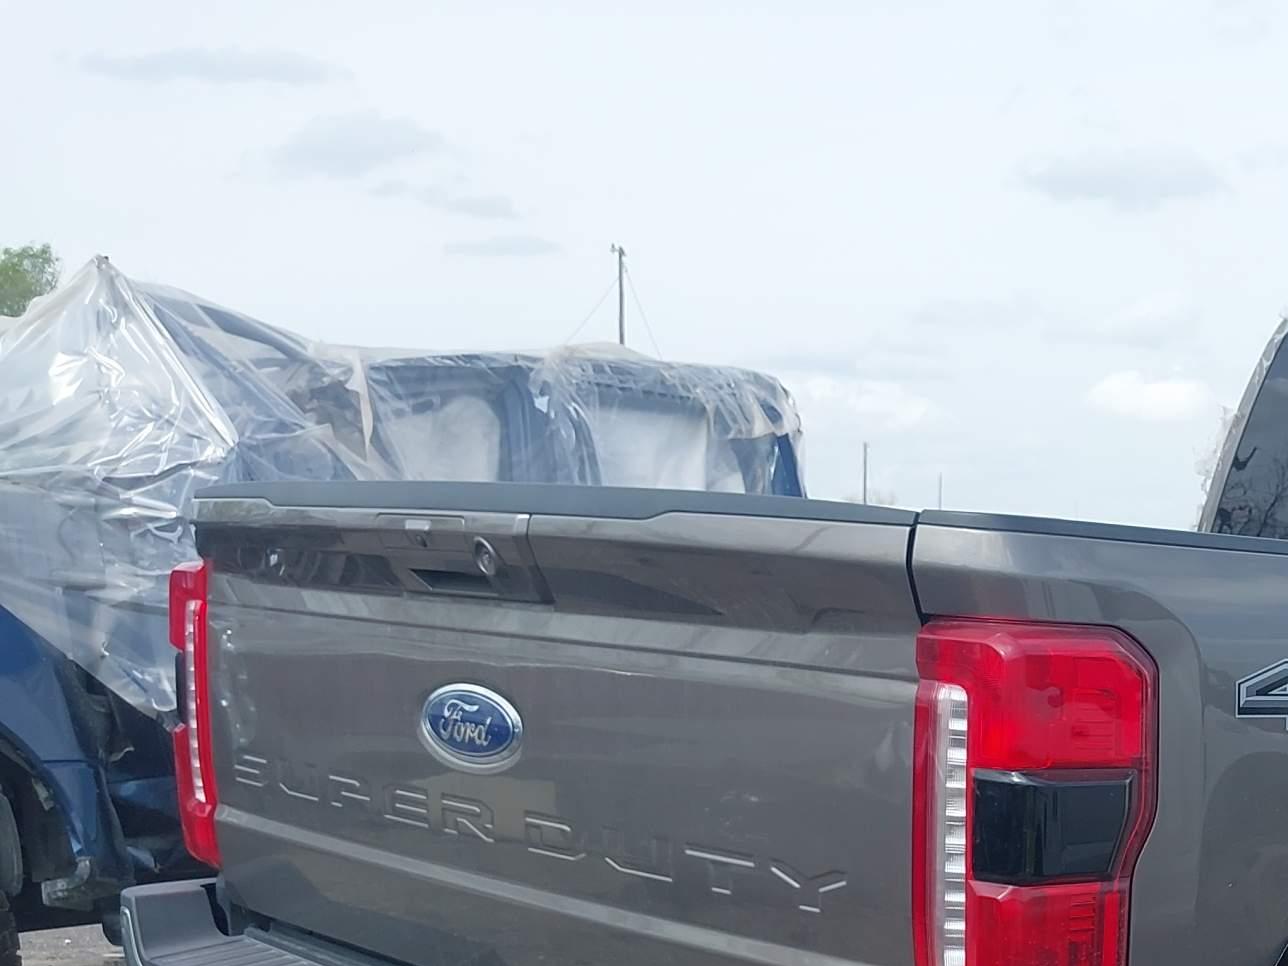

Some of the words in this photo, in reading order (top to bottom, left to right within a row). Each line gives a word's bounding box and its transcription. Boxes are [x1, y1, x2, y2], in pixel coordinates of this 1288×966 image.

[440, 699, 493, 747] Ford
[233, 754, 495, 844] SUPER
[523, 809, 848, 914] DUTY
